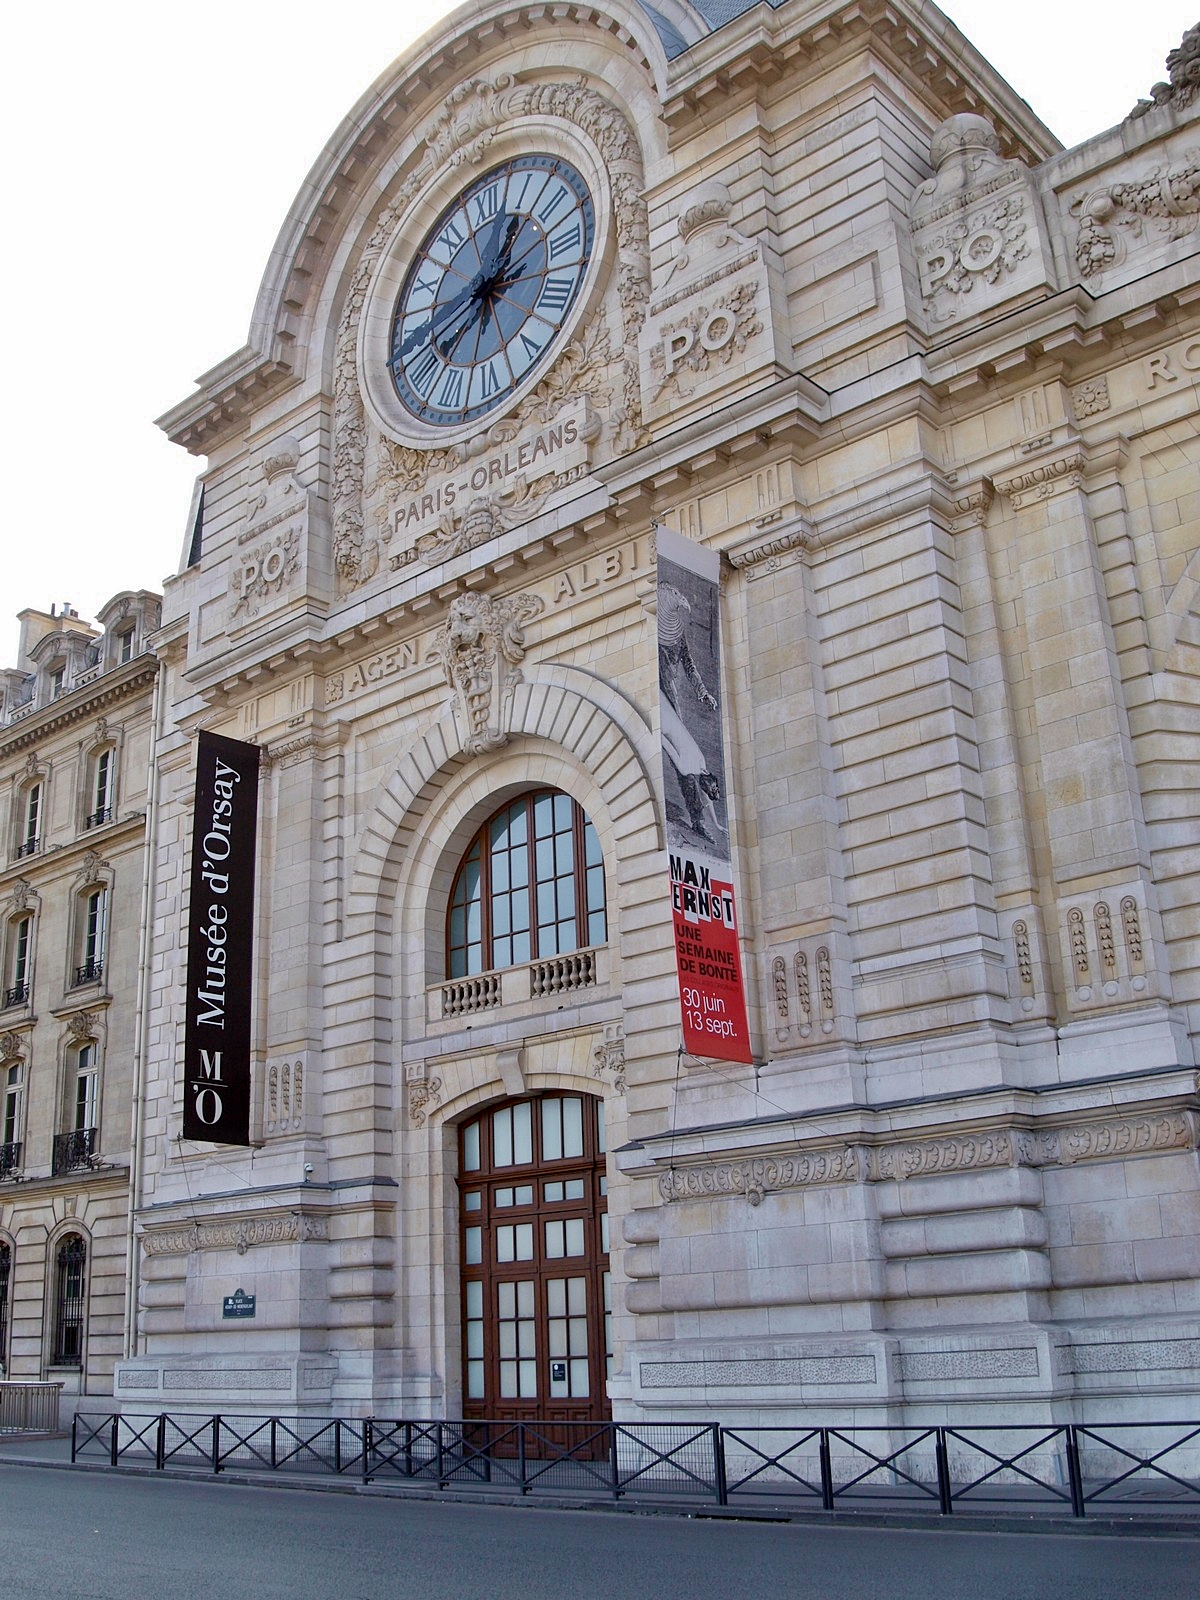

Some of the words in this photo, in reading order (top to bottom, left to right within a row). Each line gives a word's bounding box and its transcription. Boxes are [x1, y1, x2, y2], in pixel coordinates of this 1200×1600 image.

[394, 419, 578, 533] PARIS-ORLEANS
[553, 541, 638, 603] ALBI
[669, 854, 711, 892] MAX
[673, 884, 733, 922] ERNST
[676, 923, 702, 942] UNE
[196, 904, 228, 1030] Musée
[678, 940, 734, 965] SEMAINE
[680, 957, 696, 974] DE
[682, 987, 701, 1008] 30
[702, 990, 726, 1014] juin
[686, 1010, 703, 1031] 13
[705, 1017, 738, 1039] sept.
[197, 1049, 224, 1081] M
